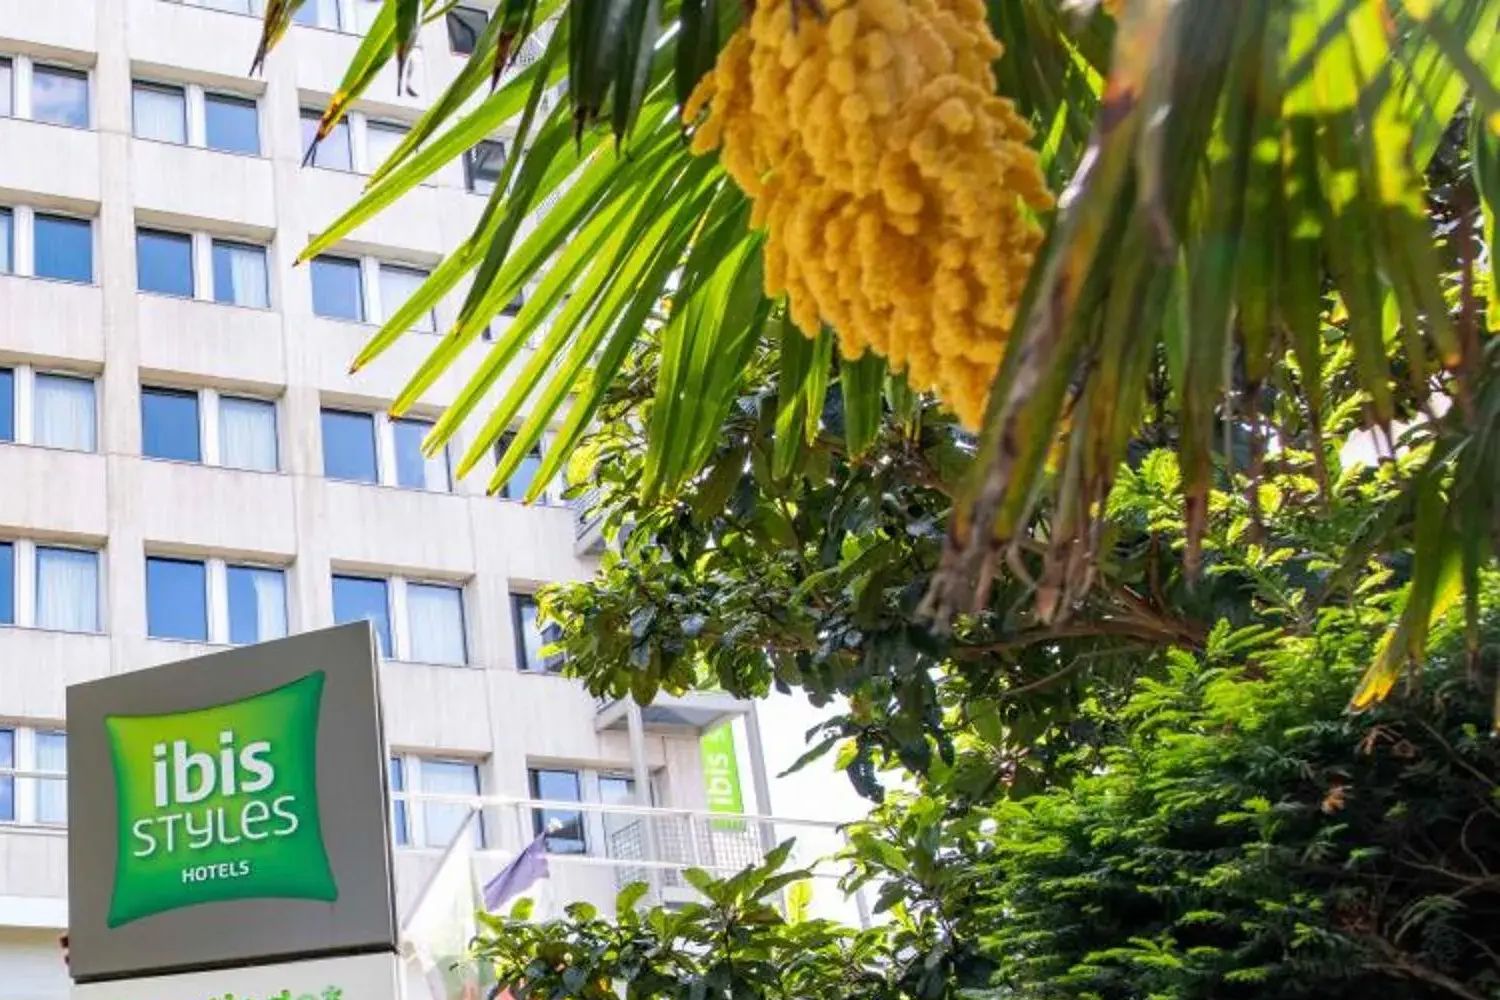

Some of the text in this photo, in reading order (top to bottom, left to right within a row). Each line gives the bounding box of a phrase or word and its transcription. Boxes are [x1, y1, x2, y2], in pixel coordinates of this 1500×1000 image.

[152, 730, 276, 807] ibis
[705, 752, 734, 805] ibis
[181, 860, 250, 885] HOTELS
